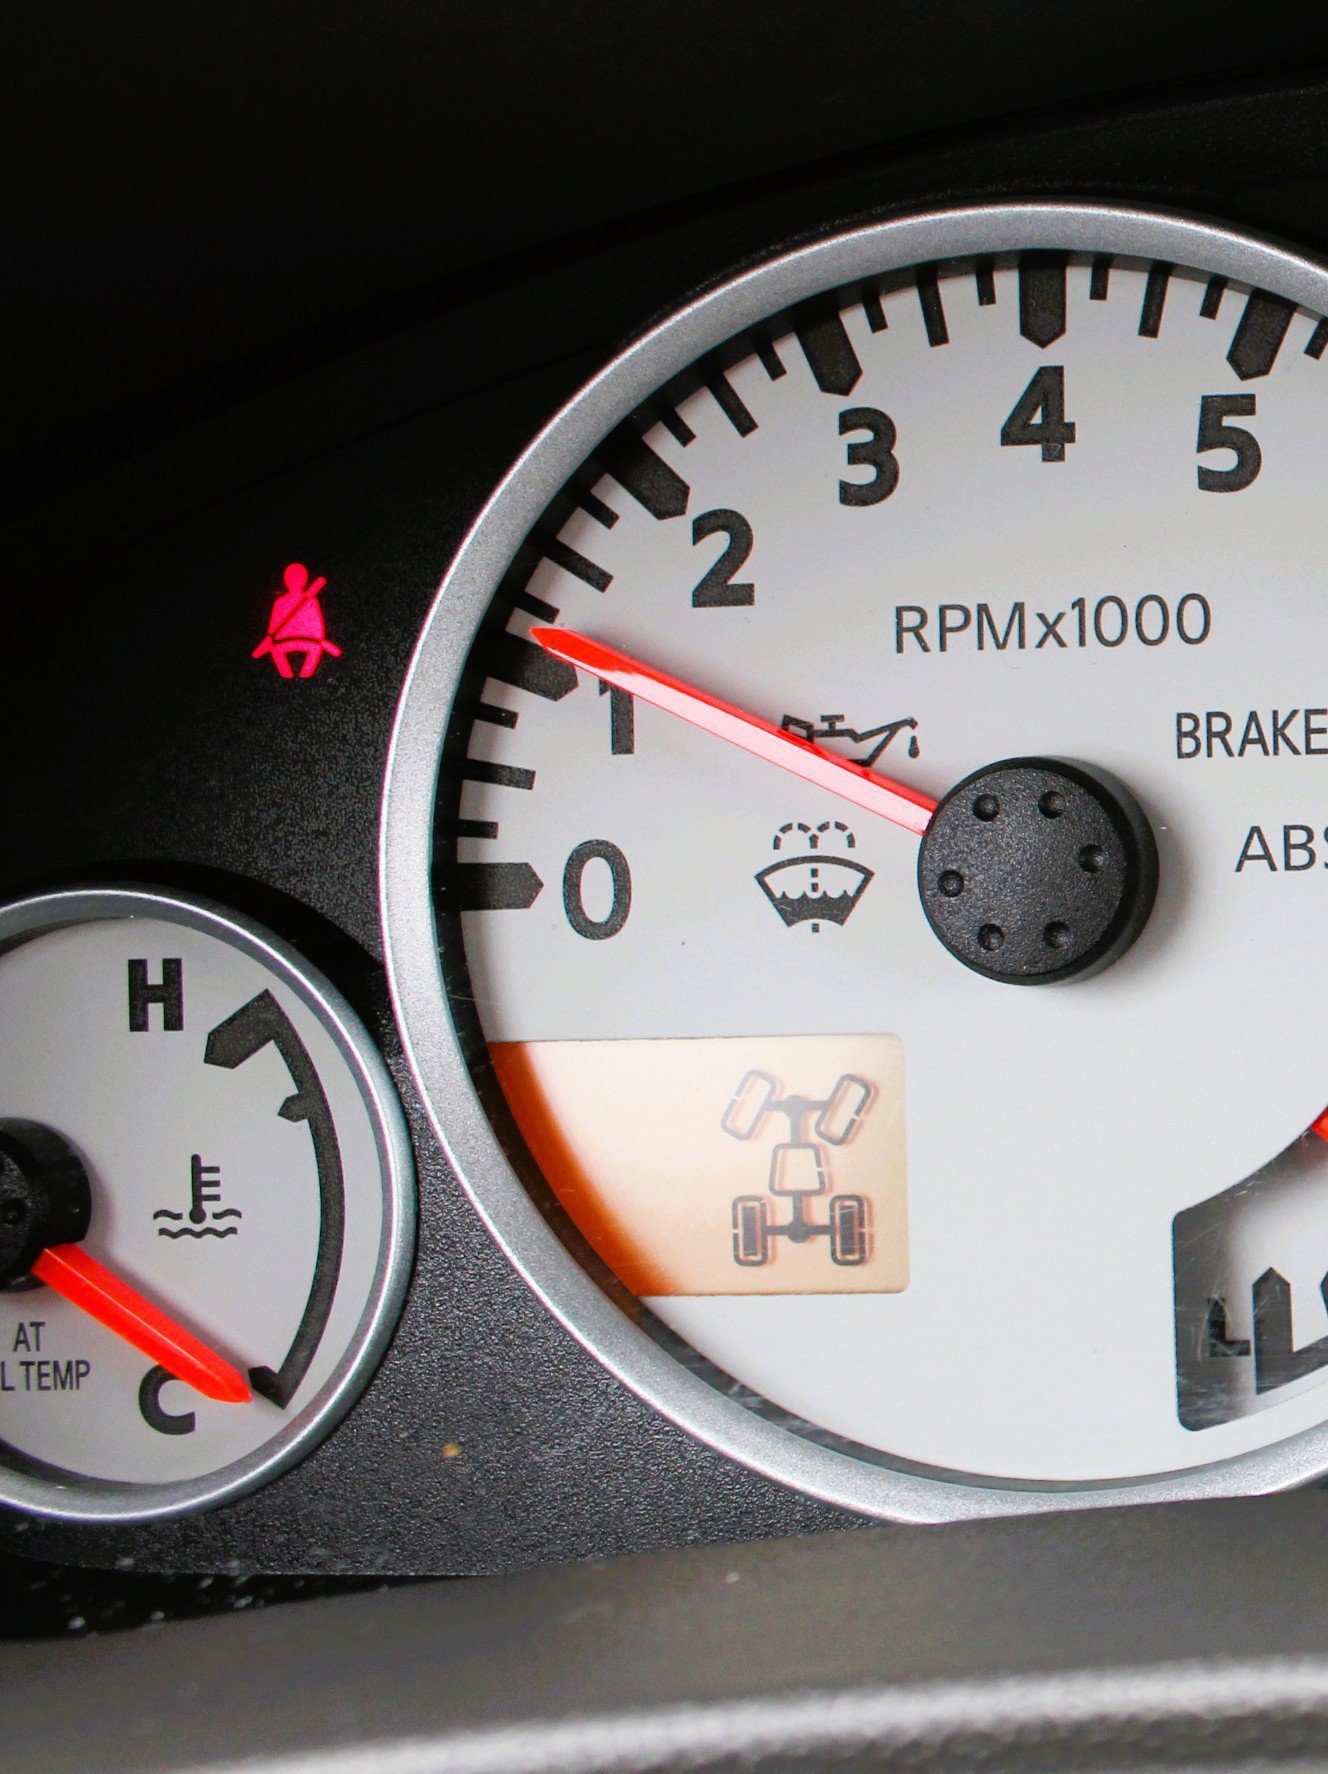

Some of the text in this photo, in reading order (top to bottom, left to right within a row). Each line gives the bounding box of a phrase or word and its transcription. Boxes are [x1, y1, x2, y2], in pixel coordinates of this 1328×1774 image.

[1001, 366, 1075, 462] 4
[1197, 394, 1261, 492] 5
[839, 407, 898, 506] 3
[692, 509, 754, 608] 2
[896, 594, 1211, 653] RPMx1000
[599, 672, 635, 755] 1
[1176, 709, 1328, 759] BRAKE
[563, 840, 631, 940] 0
[128, 958, 183, 1032] H
[13, 1321, 46, 1353] AT
[1207, 1298, 1251, 1357] L
[19, 1359, 91, 1392] TEMP
[138, 1364, 196, 1436] C
